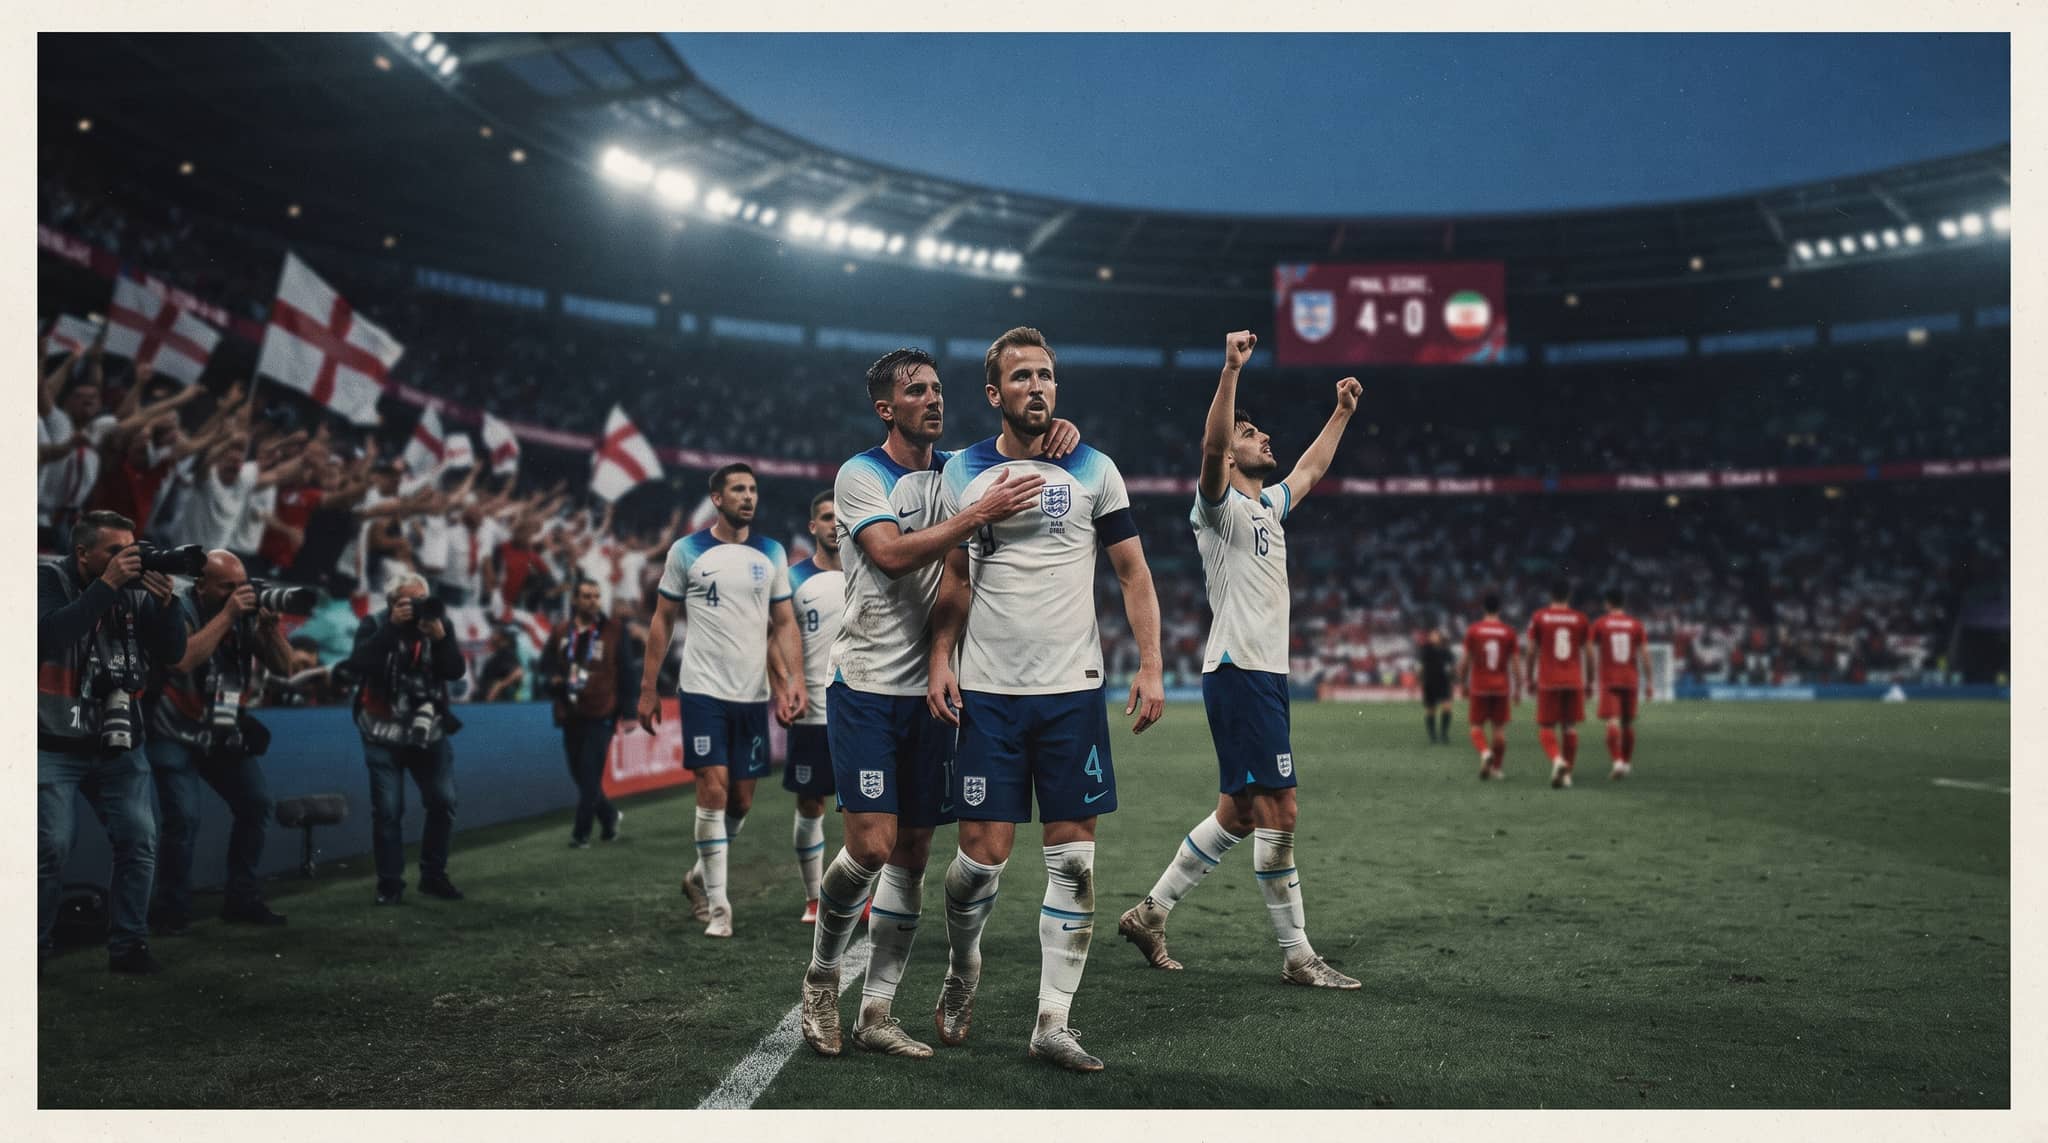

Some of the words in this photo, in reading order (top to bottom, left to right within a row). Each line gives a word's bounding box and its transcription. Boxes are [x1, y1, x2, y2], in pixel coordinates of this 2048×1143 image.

[1357, 300, 1377, 335] 4
[1404, 299, 1426, 336] 0
[706, 580, 721, 607] 4
[1084, 744, 1103, 784] 4
